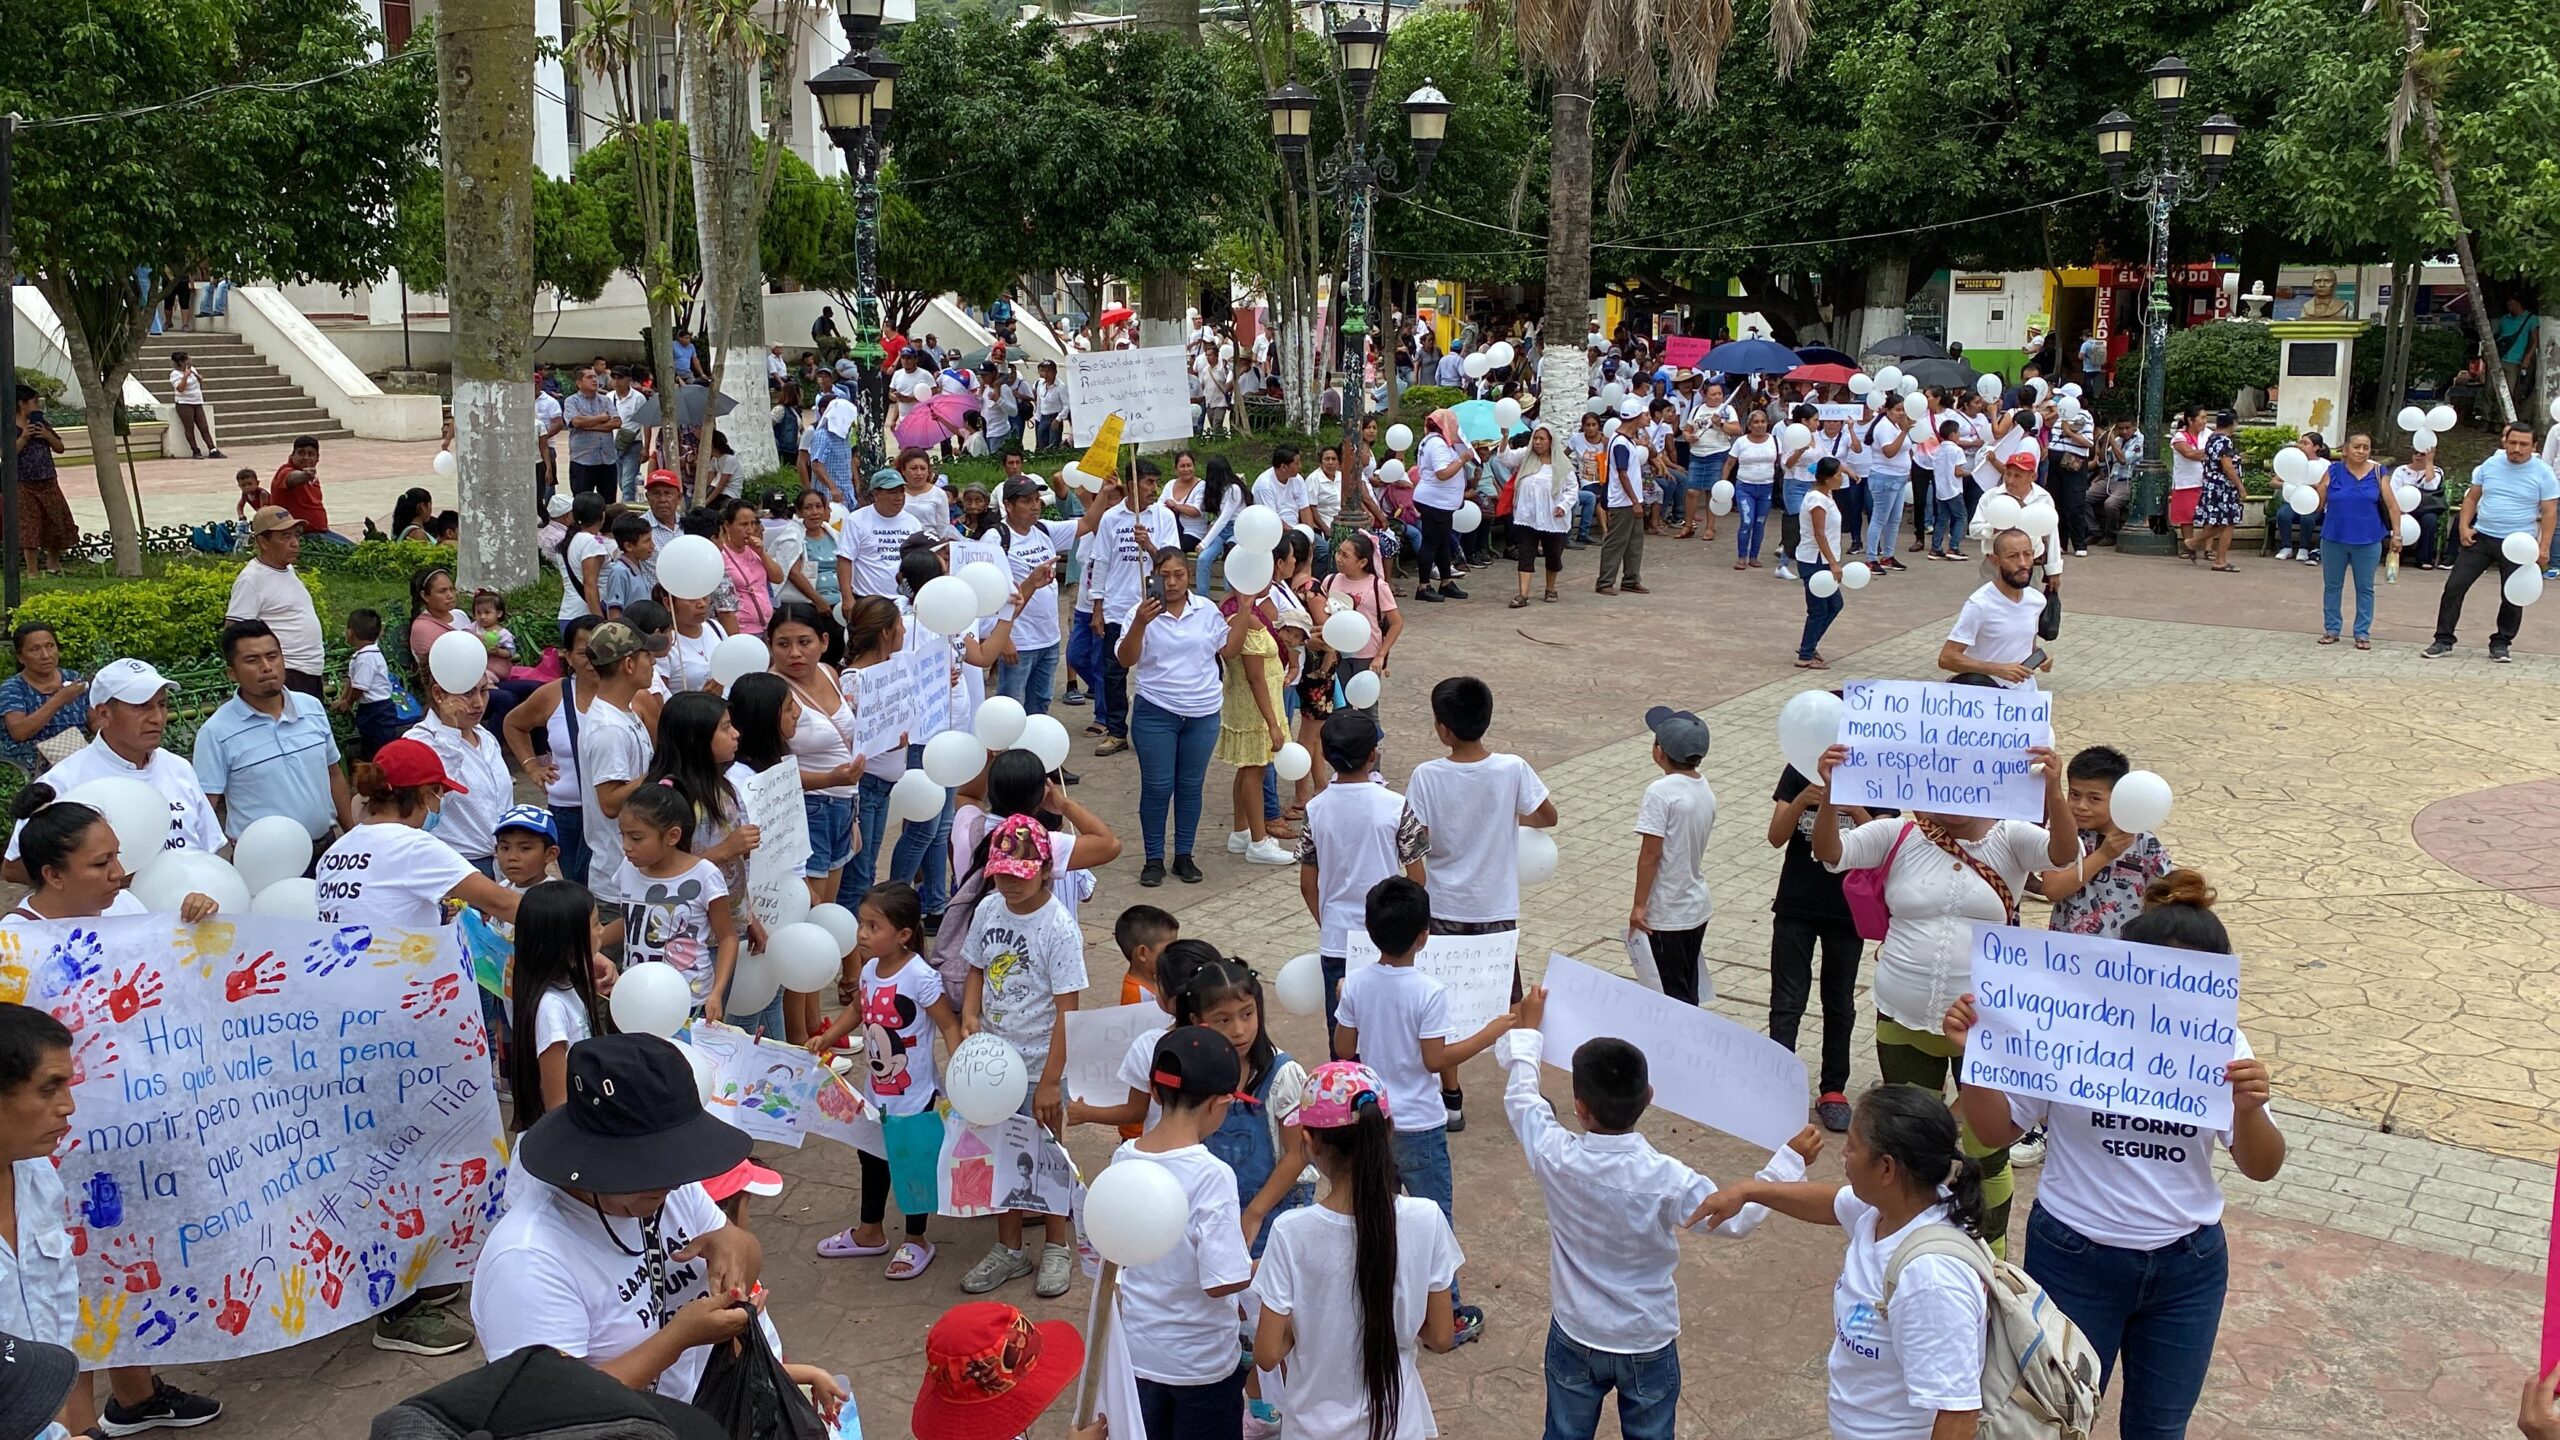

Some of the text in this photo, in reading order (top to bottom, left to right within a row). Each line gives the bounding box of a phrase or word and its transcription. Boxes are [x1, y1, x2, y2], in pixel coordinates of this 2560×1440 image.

[2118, 270, 2139, 283] EL
[1884, 694, 1909, 714] no
[1921, 687, 1985, 719] luchas
[1993, 696, 2027, 722] ten
[2031, 700, 2049, 722] al
[1848, 720, 2031, 749] menos la decencia
[1842, 746, 1868, 768] de
[1877, 748, 1962, 779] respetar
[1973, 758, 1985, 775] a
[1865, 778, 1883, 800] si
[1897, 775, 1913, 801] lo
[1983, 931, 2239, 1000] Que las autoridades
[139, 1009, 387, 1064] Hay causas por
[2151, 1003, 2171, 1035] la
[2180, 1018, 2234, 1046] vida
[123, 1039, 419, 1104] las que vale la pena
[952, 1057, 1008, 1088] Salud
[1980, 1029, 2227, 1088] e integridad de las
[195, 1097, 241, 1147] pero
[252, 1075, 367, 1117] ninguna
[398, 1062, 454, 1104] por
[420, 1075, 481, 1119] Tila
[2069, 1074, 2208, 1117] desplazadas
[2091, 1111, 2198, 1138] RETORNO
[139, 1104, 376, 1201] la que valga la
[1038, 1162, 1070, 1172] TILA
[2102, 1139, 2187, 1163] SEGURO
[177, 1145, 340, 1268] pena matar
[648, 1248, 665, 1316] LOLA
